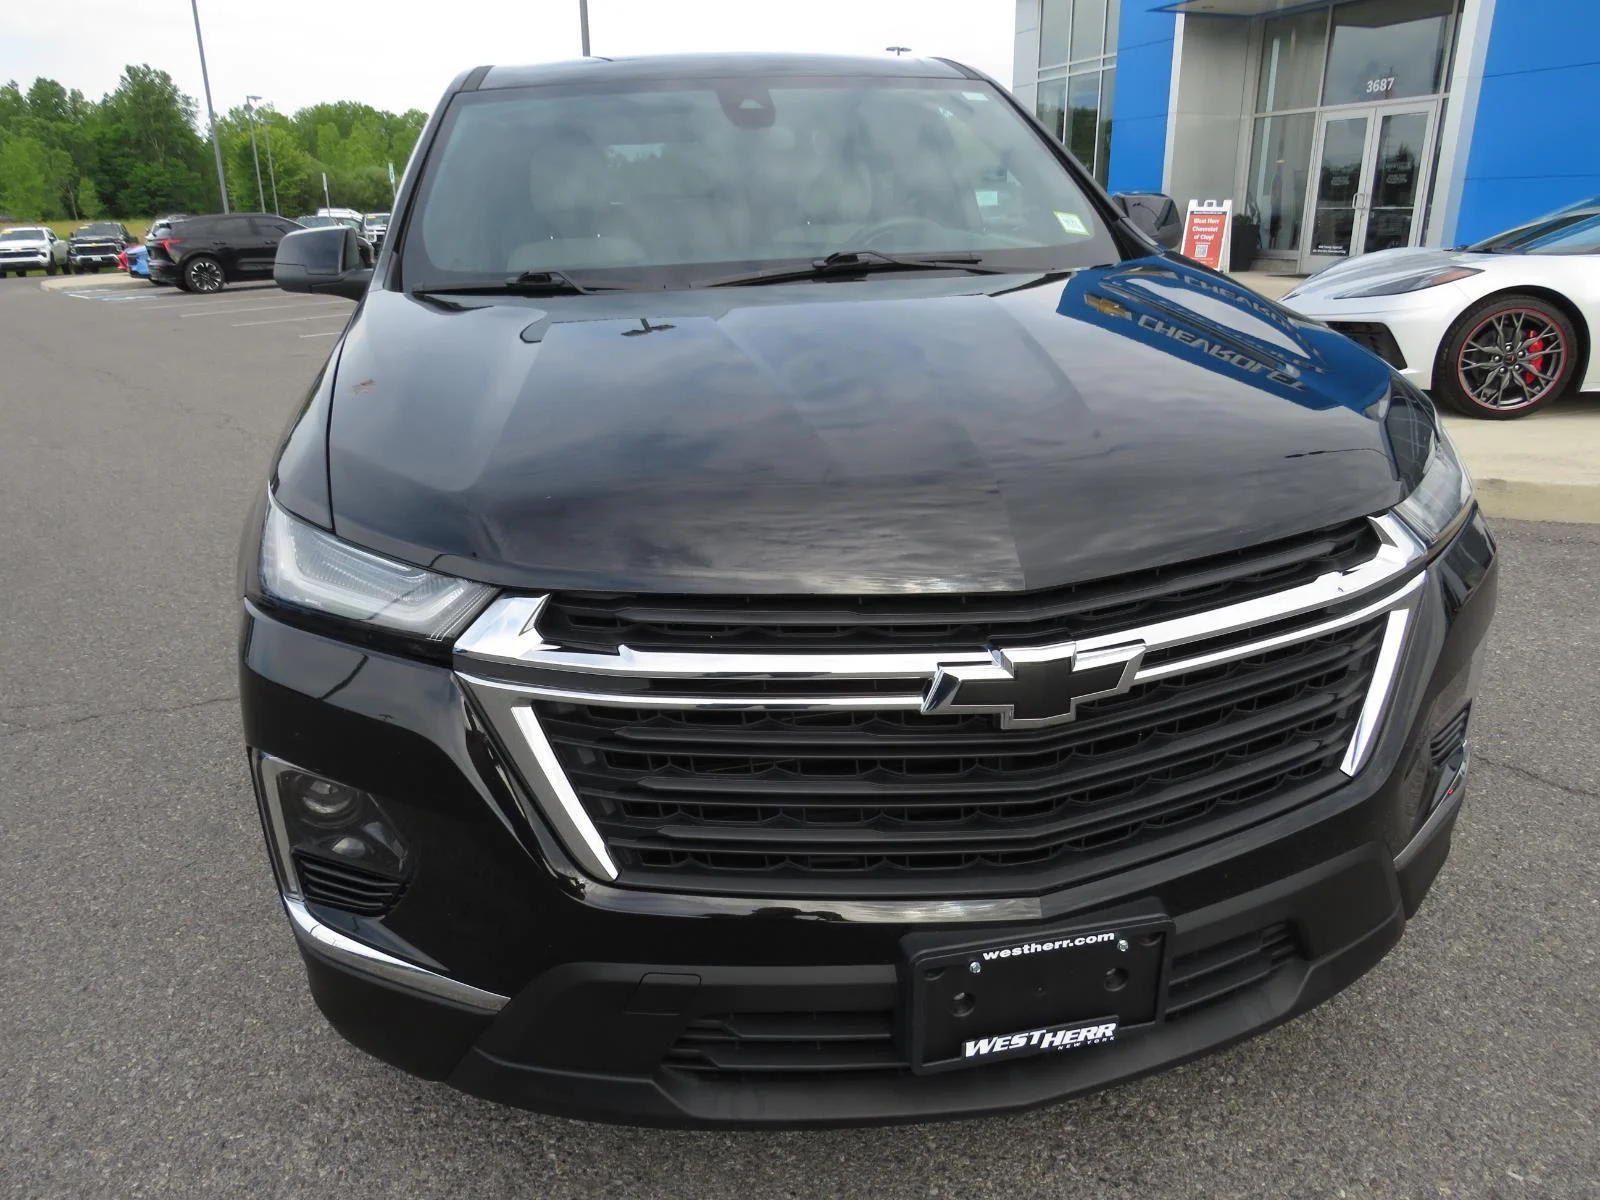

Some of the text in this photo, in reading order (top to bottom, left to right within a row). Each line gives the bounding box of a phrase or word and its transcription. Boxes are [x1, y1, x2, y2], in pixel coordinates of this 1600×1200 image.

[1366, 77, 1395, 93] 3687
[982, 932, 1115, 961] westherr.com
[1057, 1036, 1116, 1051] NEW YORK
